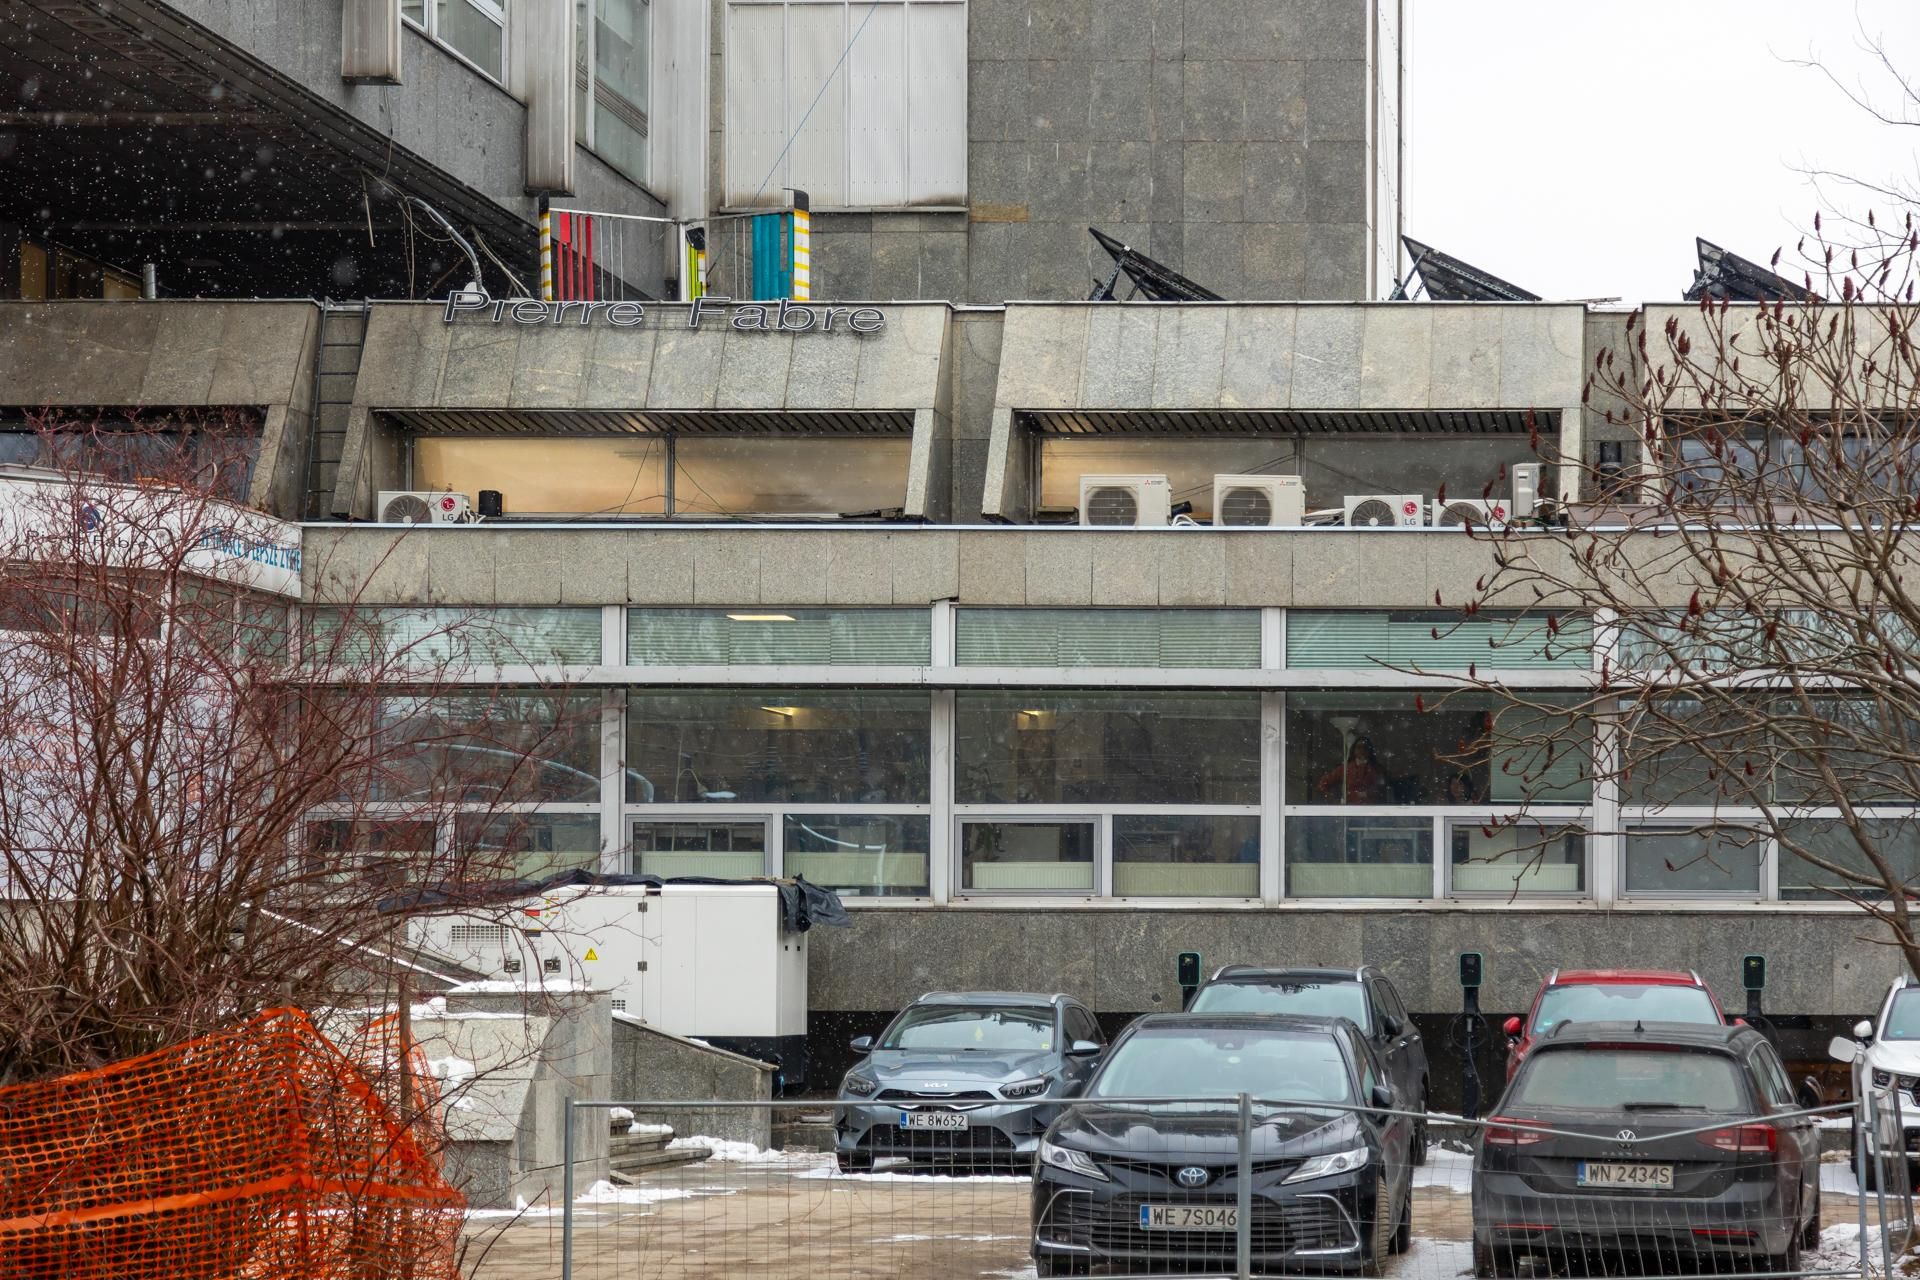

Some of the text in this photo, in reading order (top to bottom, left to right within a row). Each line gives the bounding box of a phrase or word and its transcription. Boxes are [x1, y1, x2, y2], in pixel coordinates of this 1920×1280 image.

[444, 290, 886, 332] Pierre Fabre
[442, 513, 454, 521] LG
[1404, 518, 1417, 526] LG
[93, 534, 149, 549] Fabe
[909, 1114, 965, 1127] WE 8W652
[1589, 1165, 1611, 1182] WN
[1153, 1208, 1237, 1226] WE 7S046
